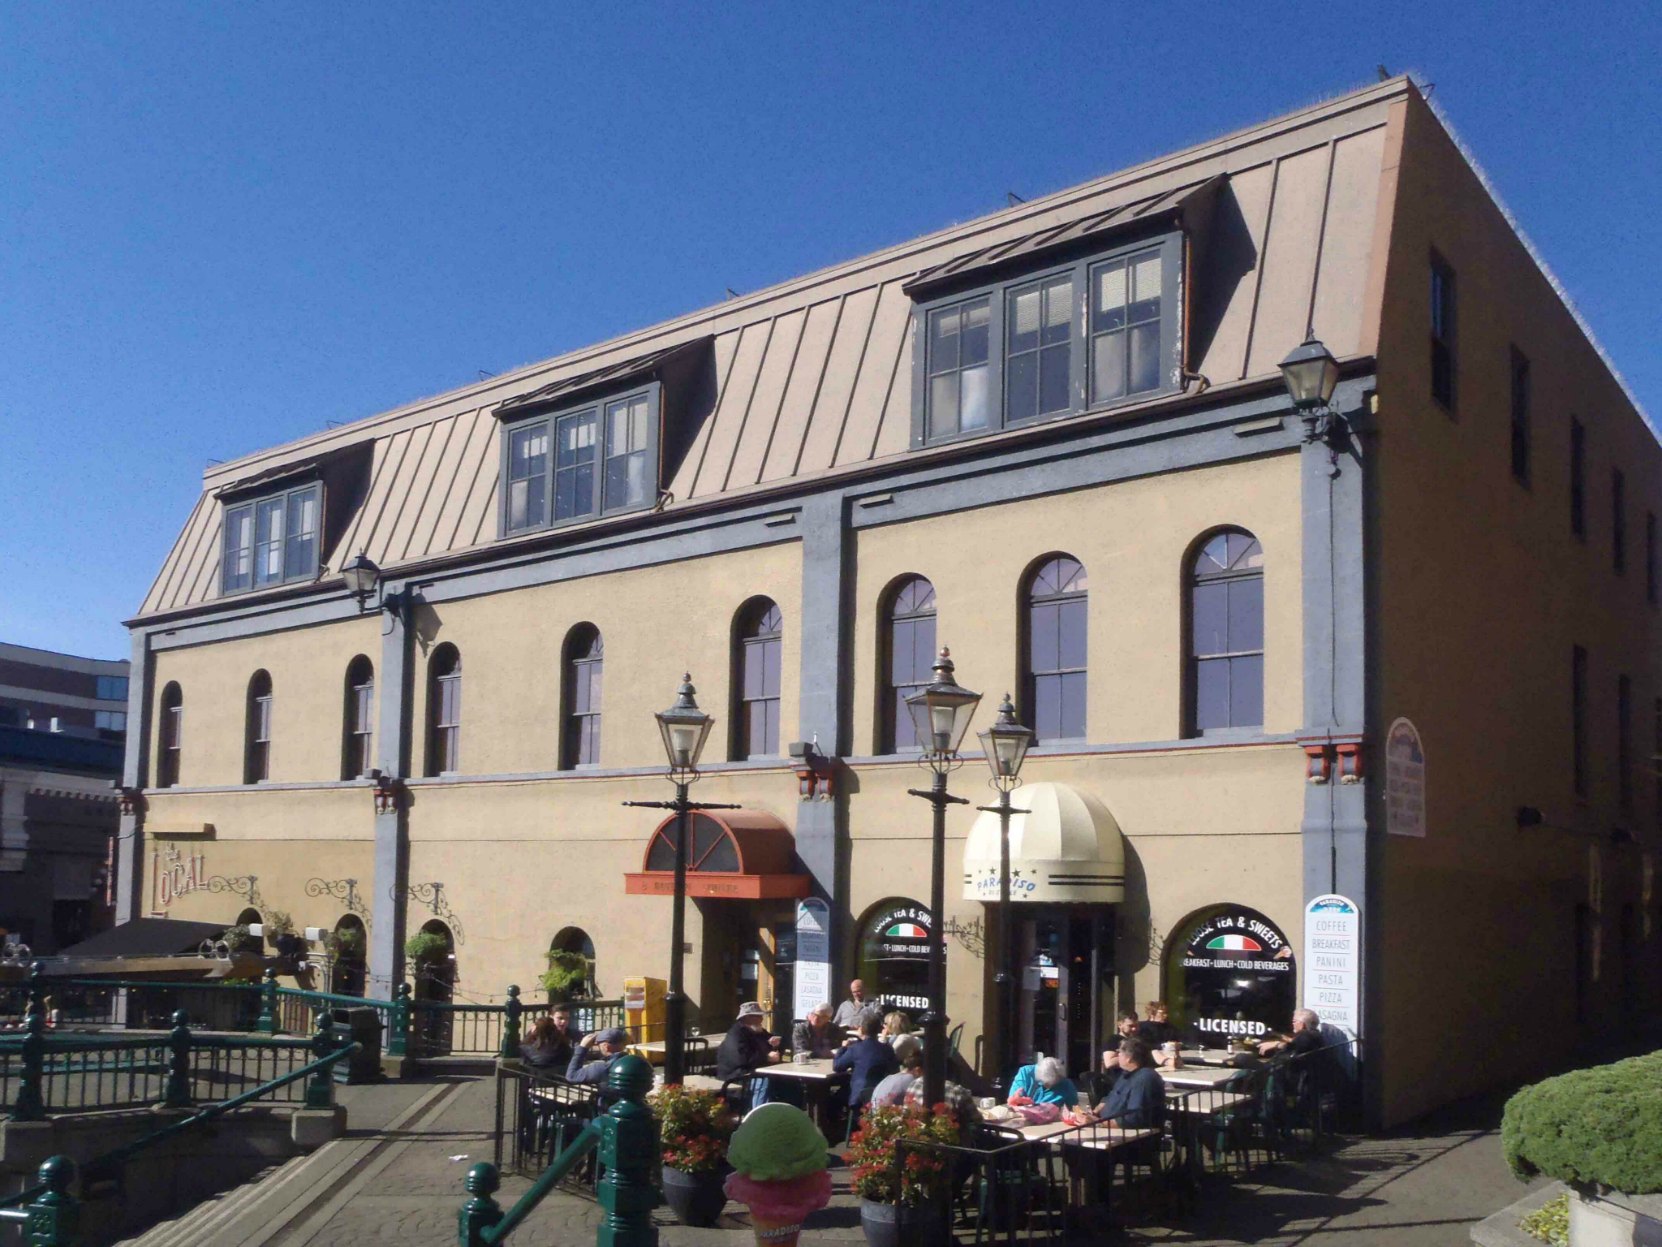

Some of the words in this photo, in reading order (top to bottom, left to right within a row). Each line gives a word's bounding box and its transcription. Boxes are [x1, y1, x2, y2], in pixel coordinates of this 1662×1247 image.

[151, 851, 210, 918] LOCAL
[908, 907, 916, 919] &
[1316, 920, 1347, 932] COFFEE
[1236, 916, 1247, 928] &
[1247, 919, 1283, 949] SWEETS
[1311, 938, 1351, 950] BREAKFAST
[1213, 959, 1234, 969] LUNCH
[1236, 960, 1253, 969] COLD
[1253, 961, 1290, 971] BEVERAGES
[1316, 956, 1347, 968] PANINI
[1318, 974, 1344, 985] PASTA
[1319, 991, 1343, 1003] PIZZA
[1199, 1017, 1266, 1036] LICENSED
